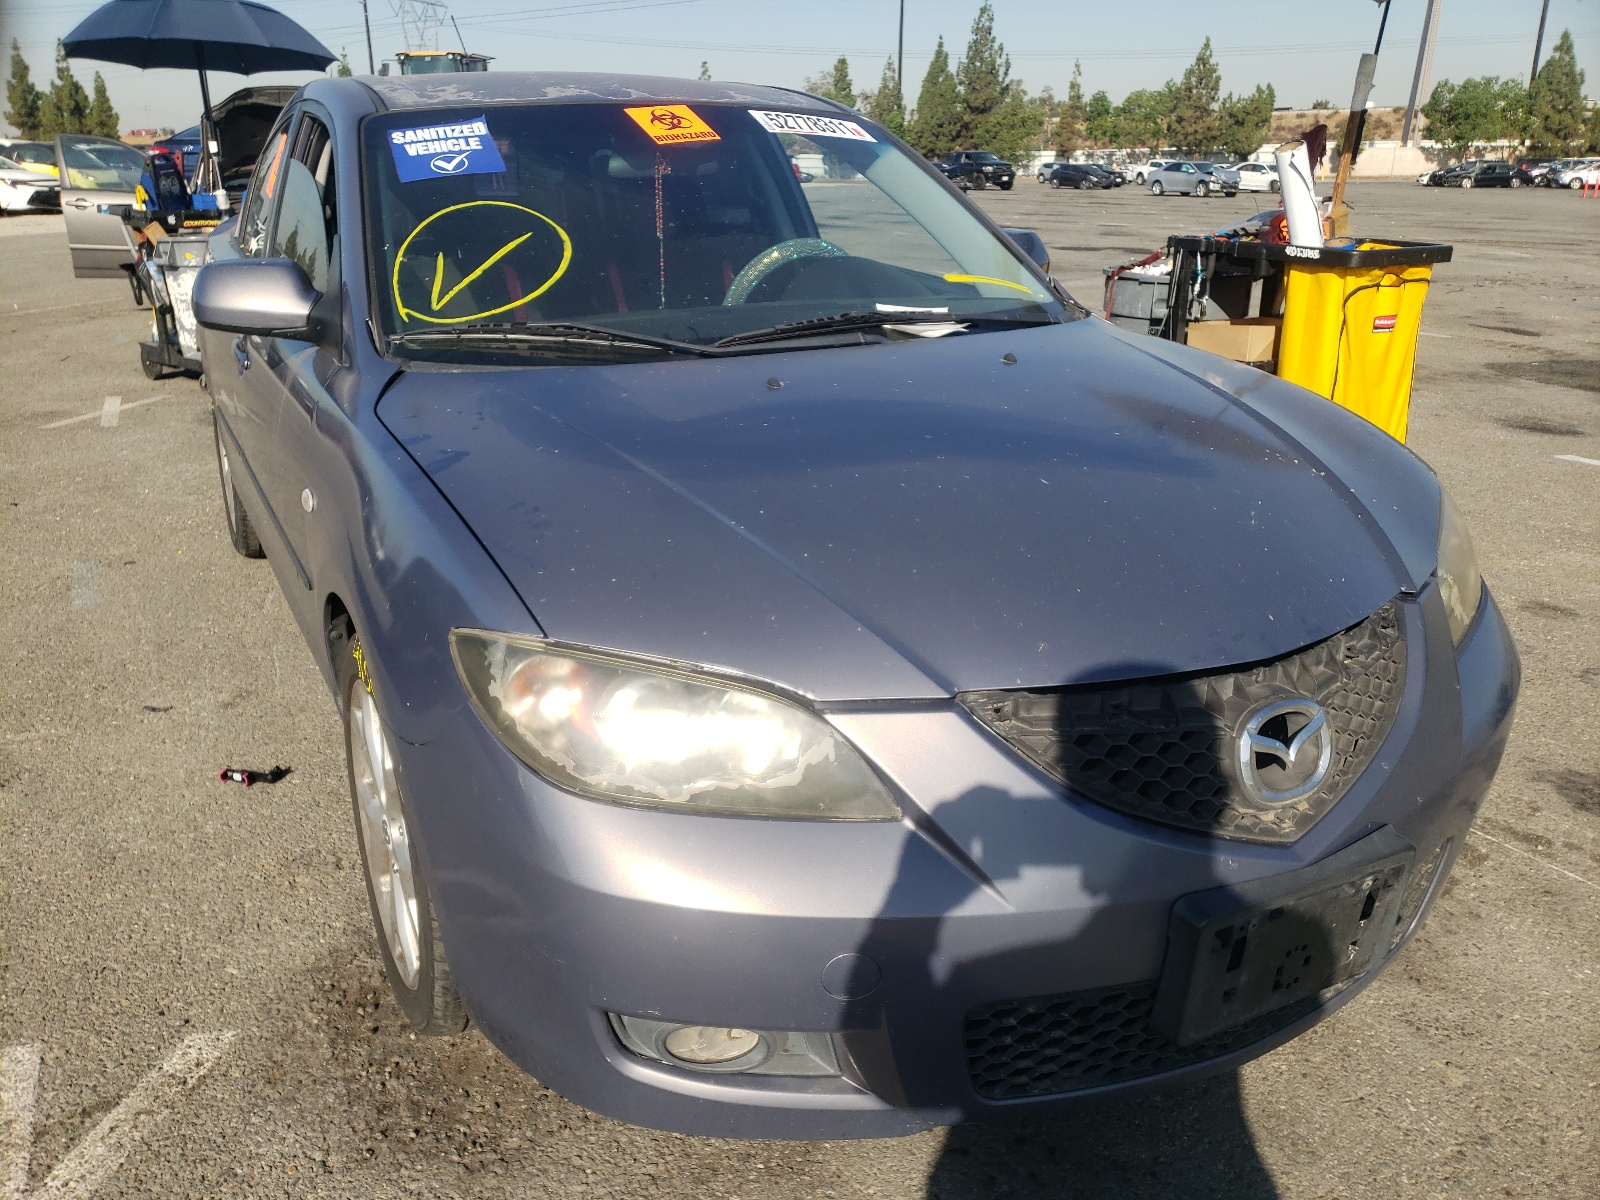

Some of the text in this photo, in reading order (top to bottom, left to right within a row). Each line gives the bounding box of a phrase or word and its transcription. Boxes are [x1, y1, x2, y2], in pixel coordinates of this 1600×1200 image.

[391, 121, 487, 144] SANITIZED
[762, 112, 857, 136] 52778311
[404, 137, 483, 156] VEHICLE
[654, 132, 717, 142] BIOHAZARD
